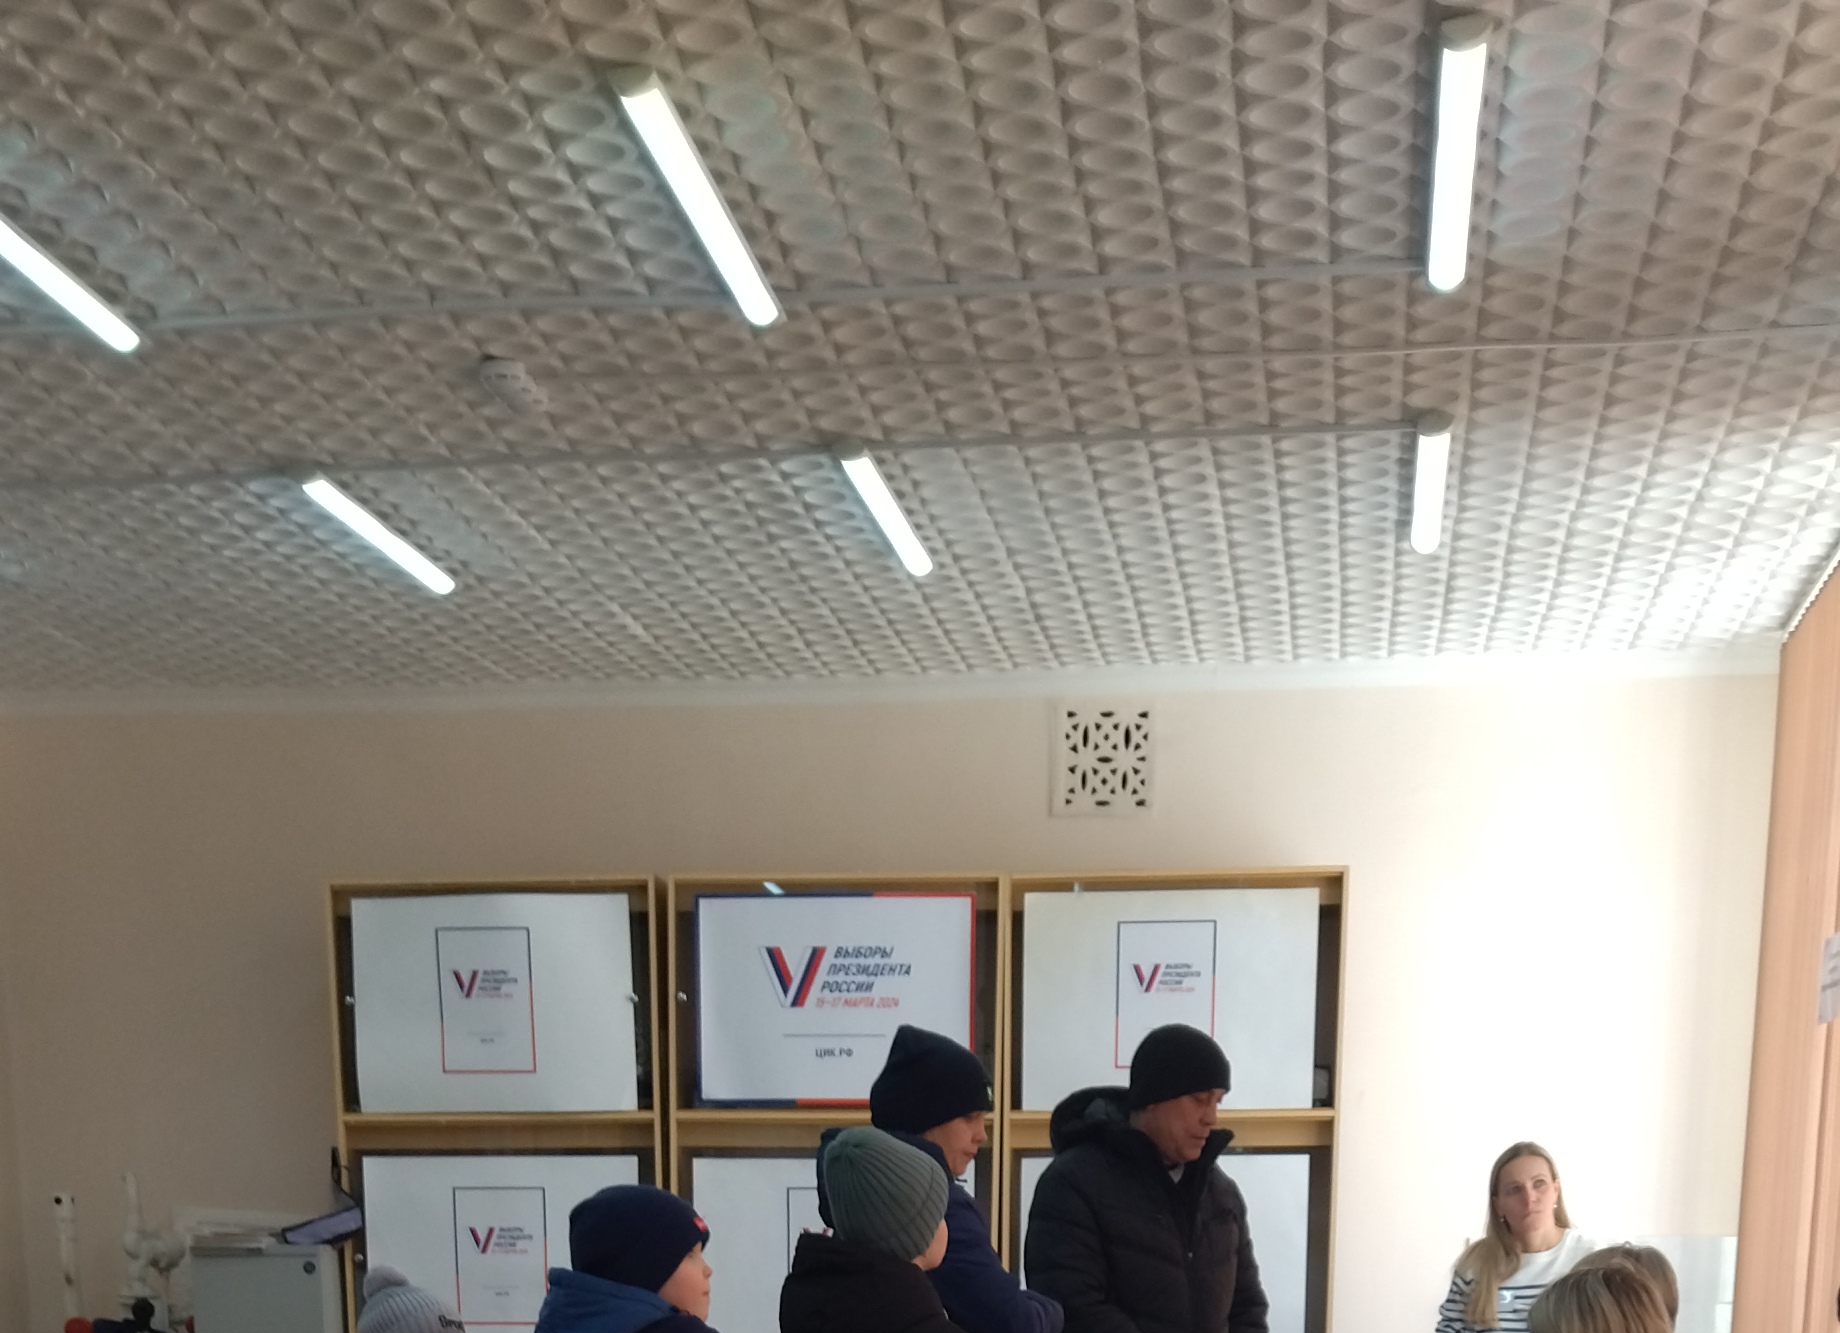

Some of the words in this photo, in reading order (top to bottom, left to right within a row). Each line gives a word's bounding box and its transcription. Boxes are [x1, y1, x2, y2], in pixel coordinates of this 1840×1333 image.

[834, 946, 894, 959] ВЫБОРЫ
[827, 963, 912, 977] ПРЕЗИДЕНТА
[820, 981, 875, 993] РОССИИ
